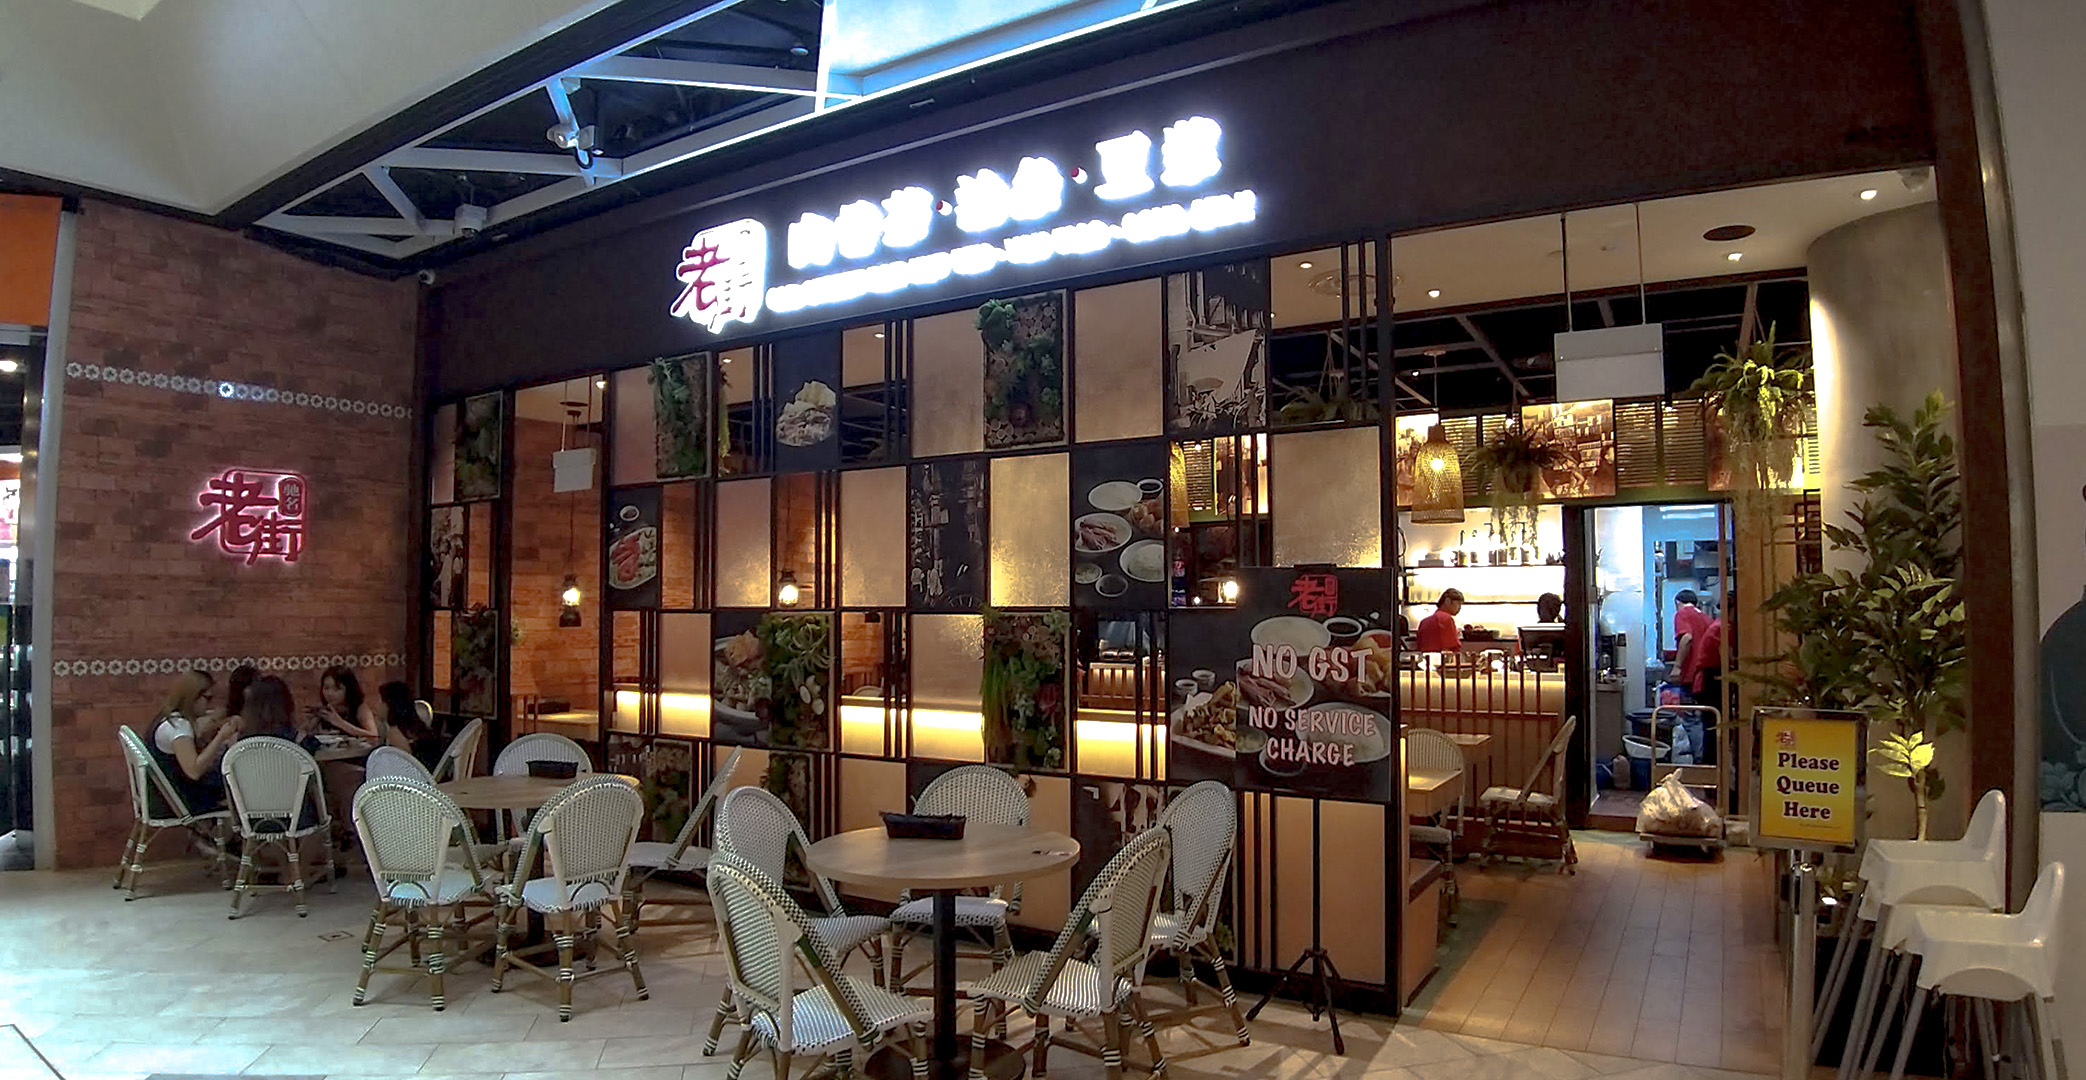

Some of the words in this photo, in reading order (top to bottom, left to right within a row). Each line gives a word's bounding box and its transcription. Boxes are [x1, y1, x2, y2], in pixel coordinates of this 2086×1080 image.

[191, 472, 302, 564] 老街
[1287, 575, 1336, 618] 老街
[1252, 644, 1297, 679] NO
[1309, 646, 1373, 683] GST
[1249, 705, 1278, 729] NO
[1284, 708, 1376, 736] SERVICE
[1266, 737, 1355, 767] CHARGE
[1777, 752, 1840, 771] Please
[1776, 776, 1840, 795] Queue
[1783, 801, 1831, 819] Here
